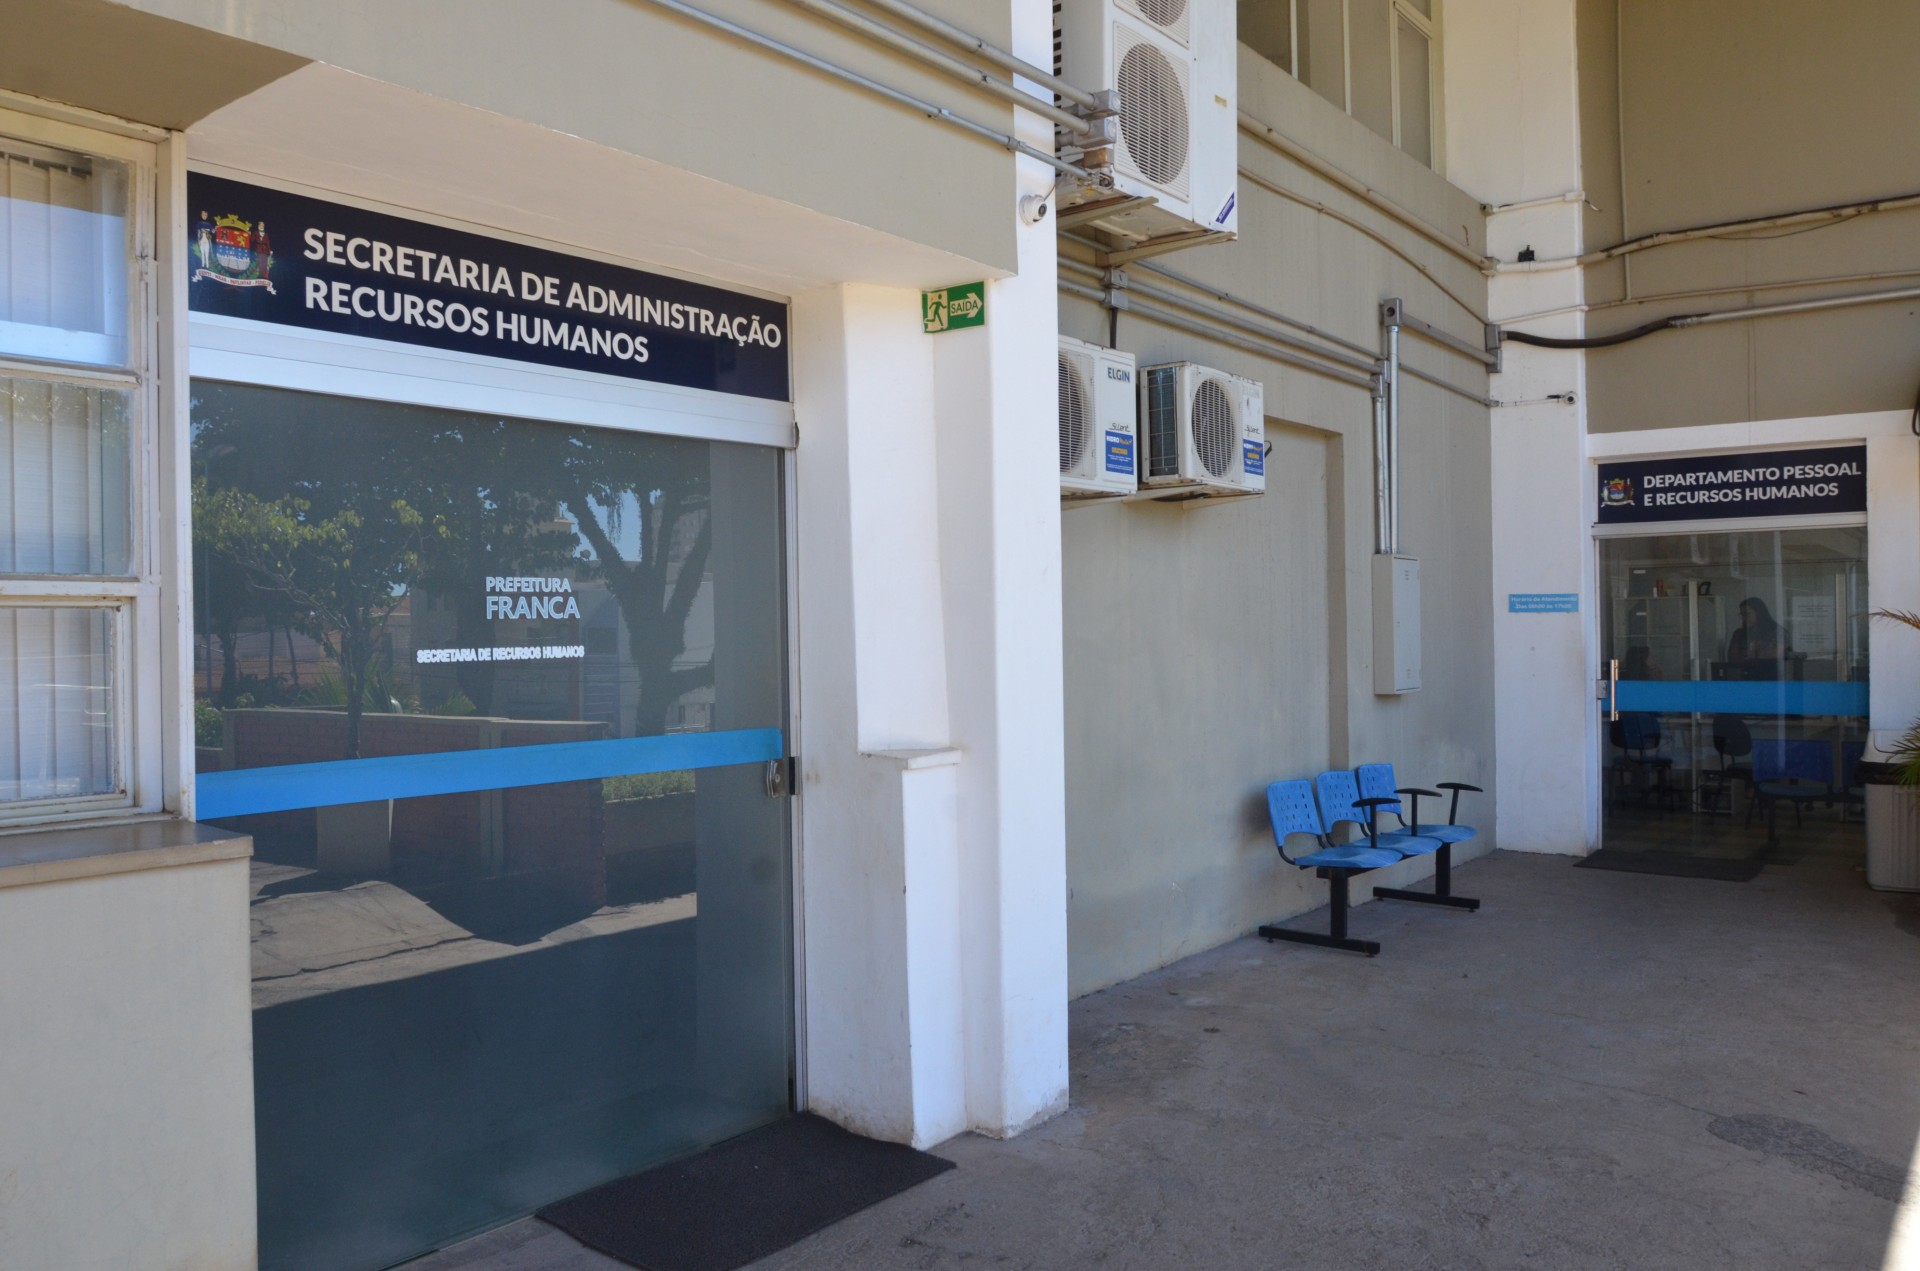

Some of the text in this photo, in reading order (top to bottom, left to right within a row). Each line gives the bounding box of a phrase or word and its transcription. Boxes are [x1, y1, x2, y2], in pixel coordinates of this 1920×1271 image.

[303, 227, 782, 348] SECRETARIA DE ADMINISTRAÇÃO
[305, 276, 649, 363] RECURSOS HUMANOS
[1107, 366, 1131, 382] ELGIN
[1643, 462, 1862, 489] DEPARTAMENTO PESSOAL
[1643, 482, 1839, 507] E RECURSOS HUMANOS
[485, 576, 572, 592] PREFEITURA
[485, 596, 581, 620] FRANCA
[416, 645, 585, 664] SECRETARIA DE RECURSOS HUMANOS
